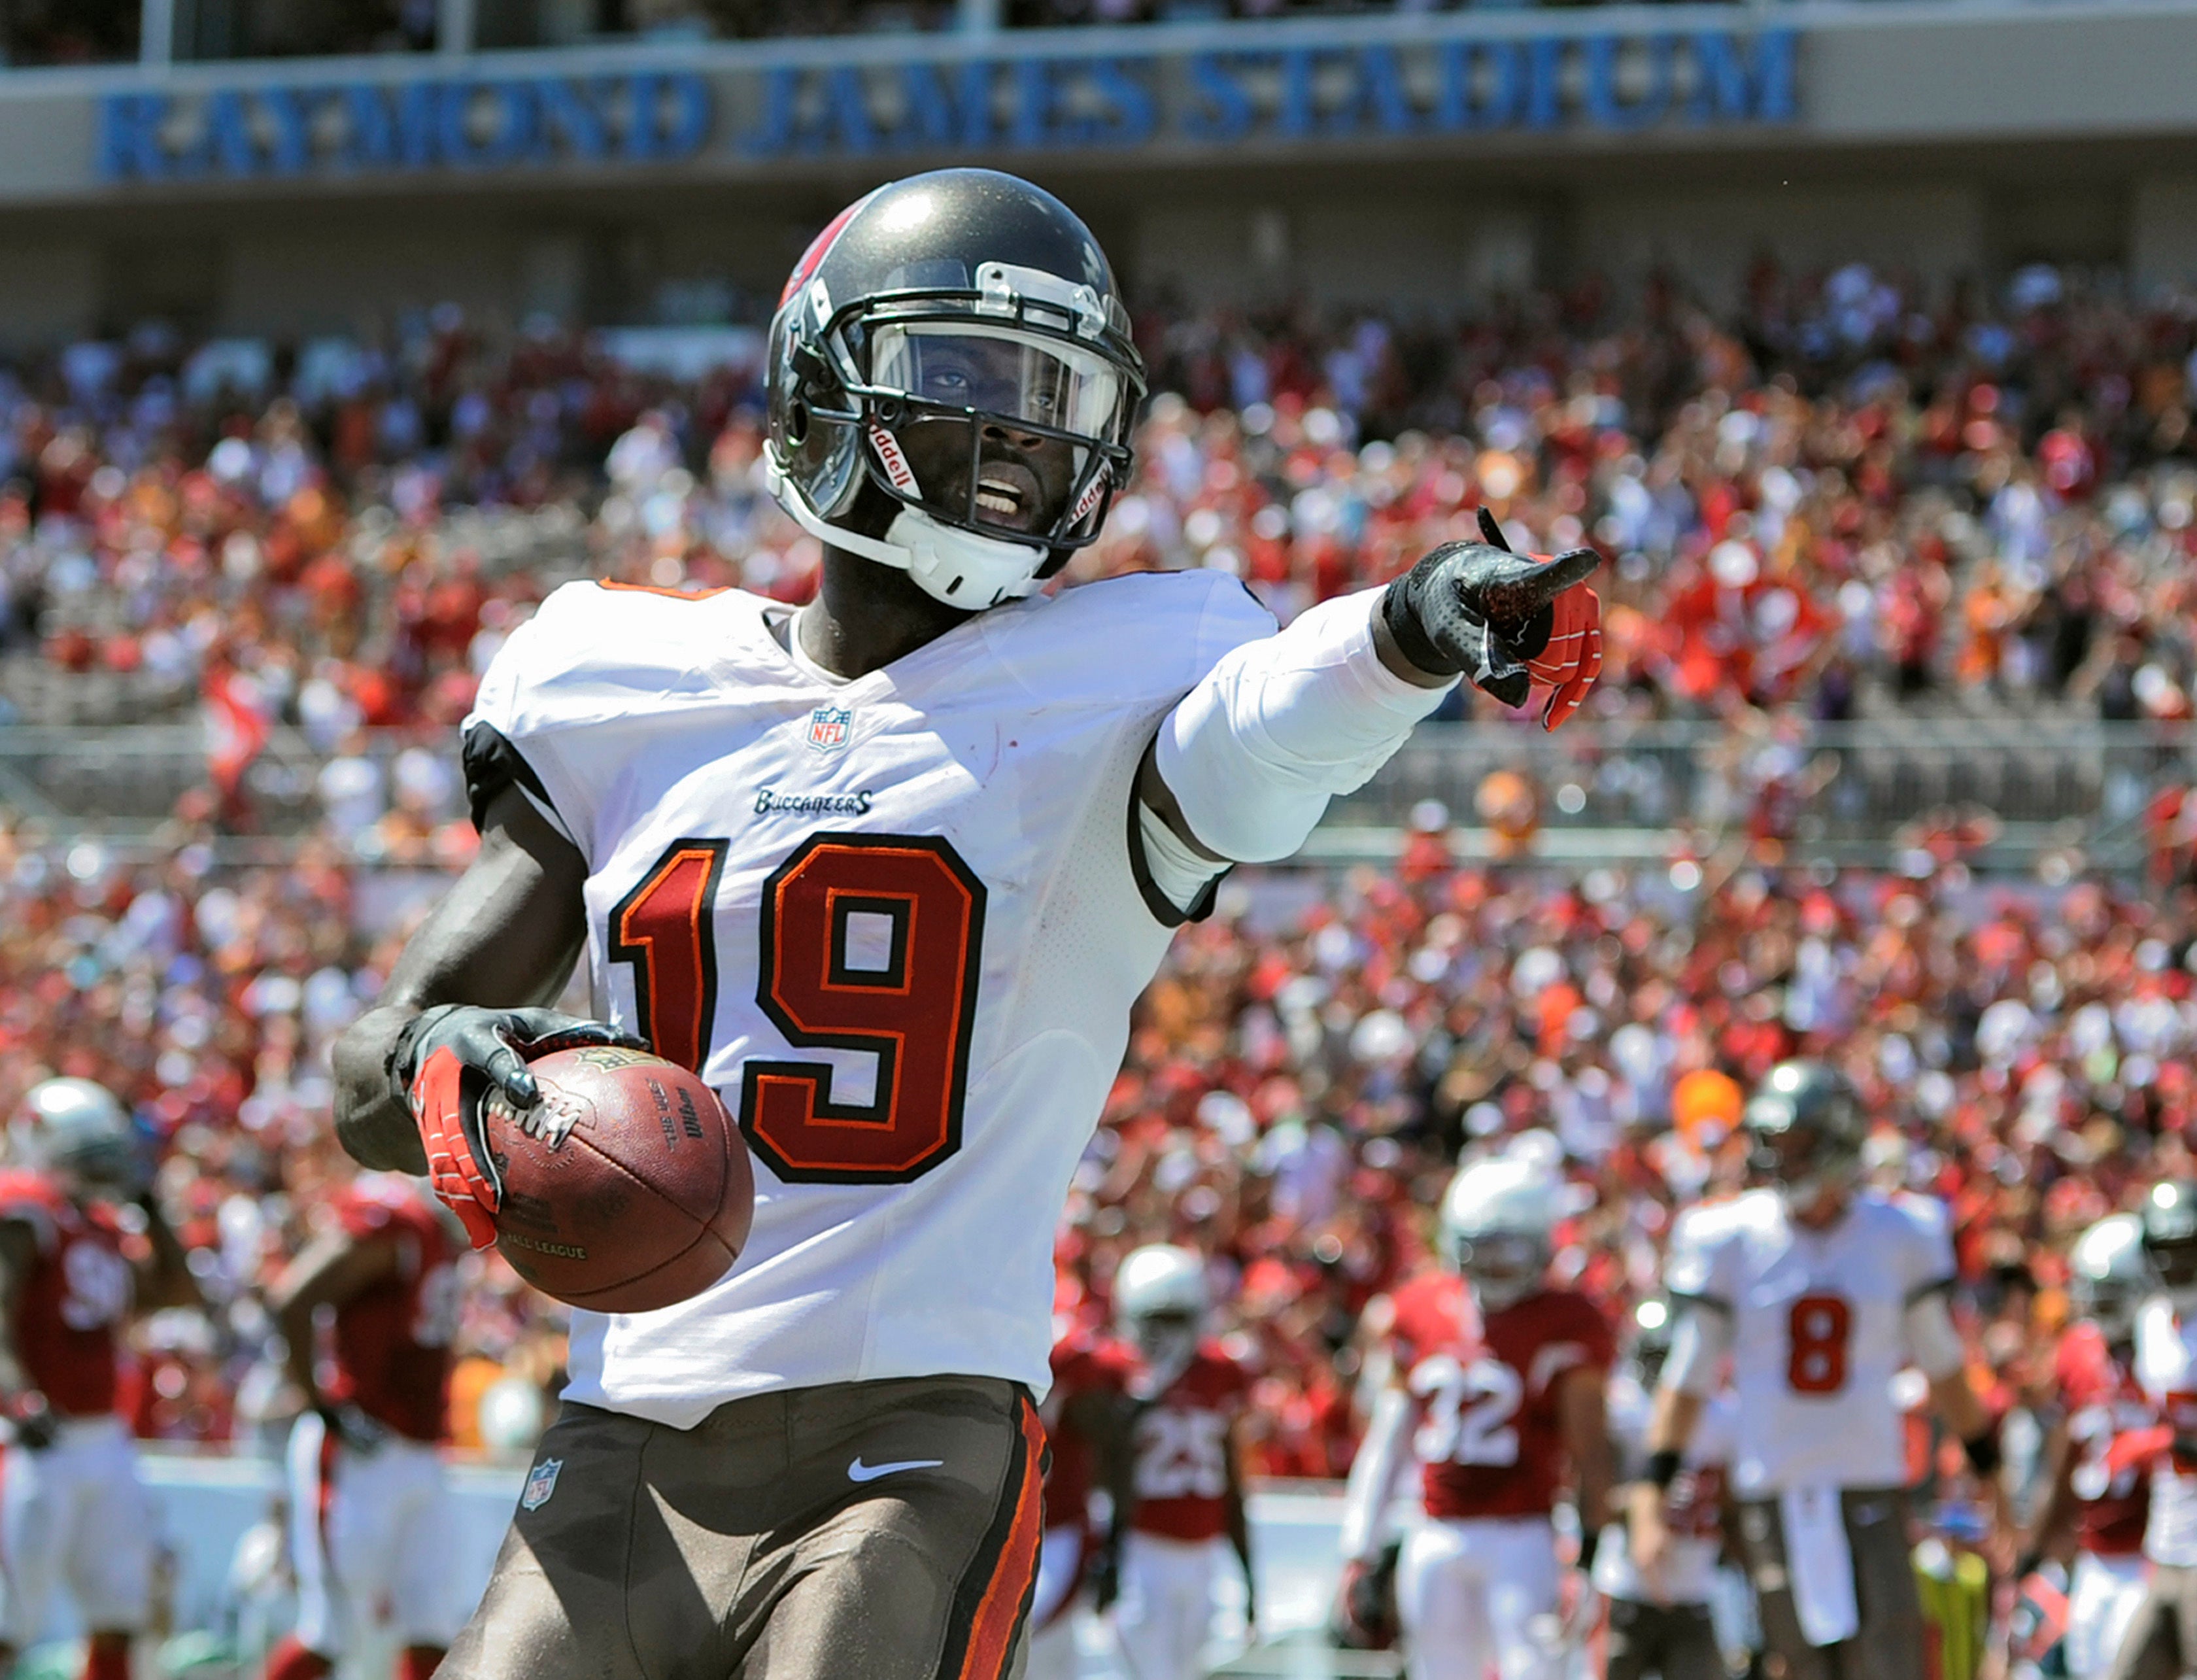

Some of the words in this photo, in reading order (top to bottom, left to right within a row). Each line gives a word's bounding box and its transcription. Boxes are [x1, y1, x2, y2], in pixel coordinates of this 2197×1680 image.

[97, 69, 711, 183] RAYMOND
[738, 47, 1159, 159] JAMES
[1183, 27, 1803, 140] STADIUM
[870, 419, 911, 487] iddell
[812, 723, 843, 744] NFL
[608, 831, 988, 1184] 19
[535, 1240, 587, 1260] LEAGUE
[1788, 1296, 1849, 1393] 8
[1132, 1405, 1228, 1500] 25
[1408, 1354, 1524, 1467] 32
